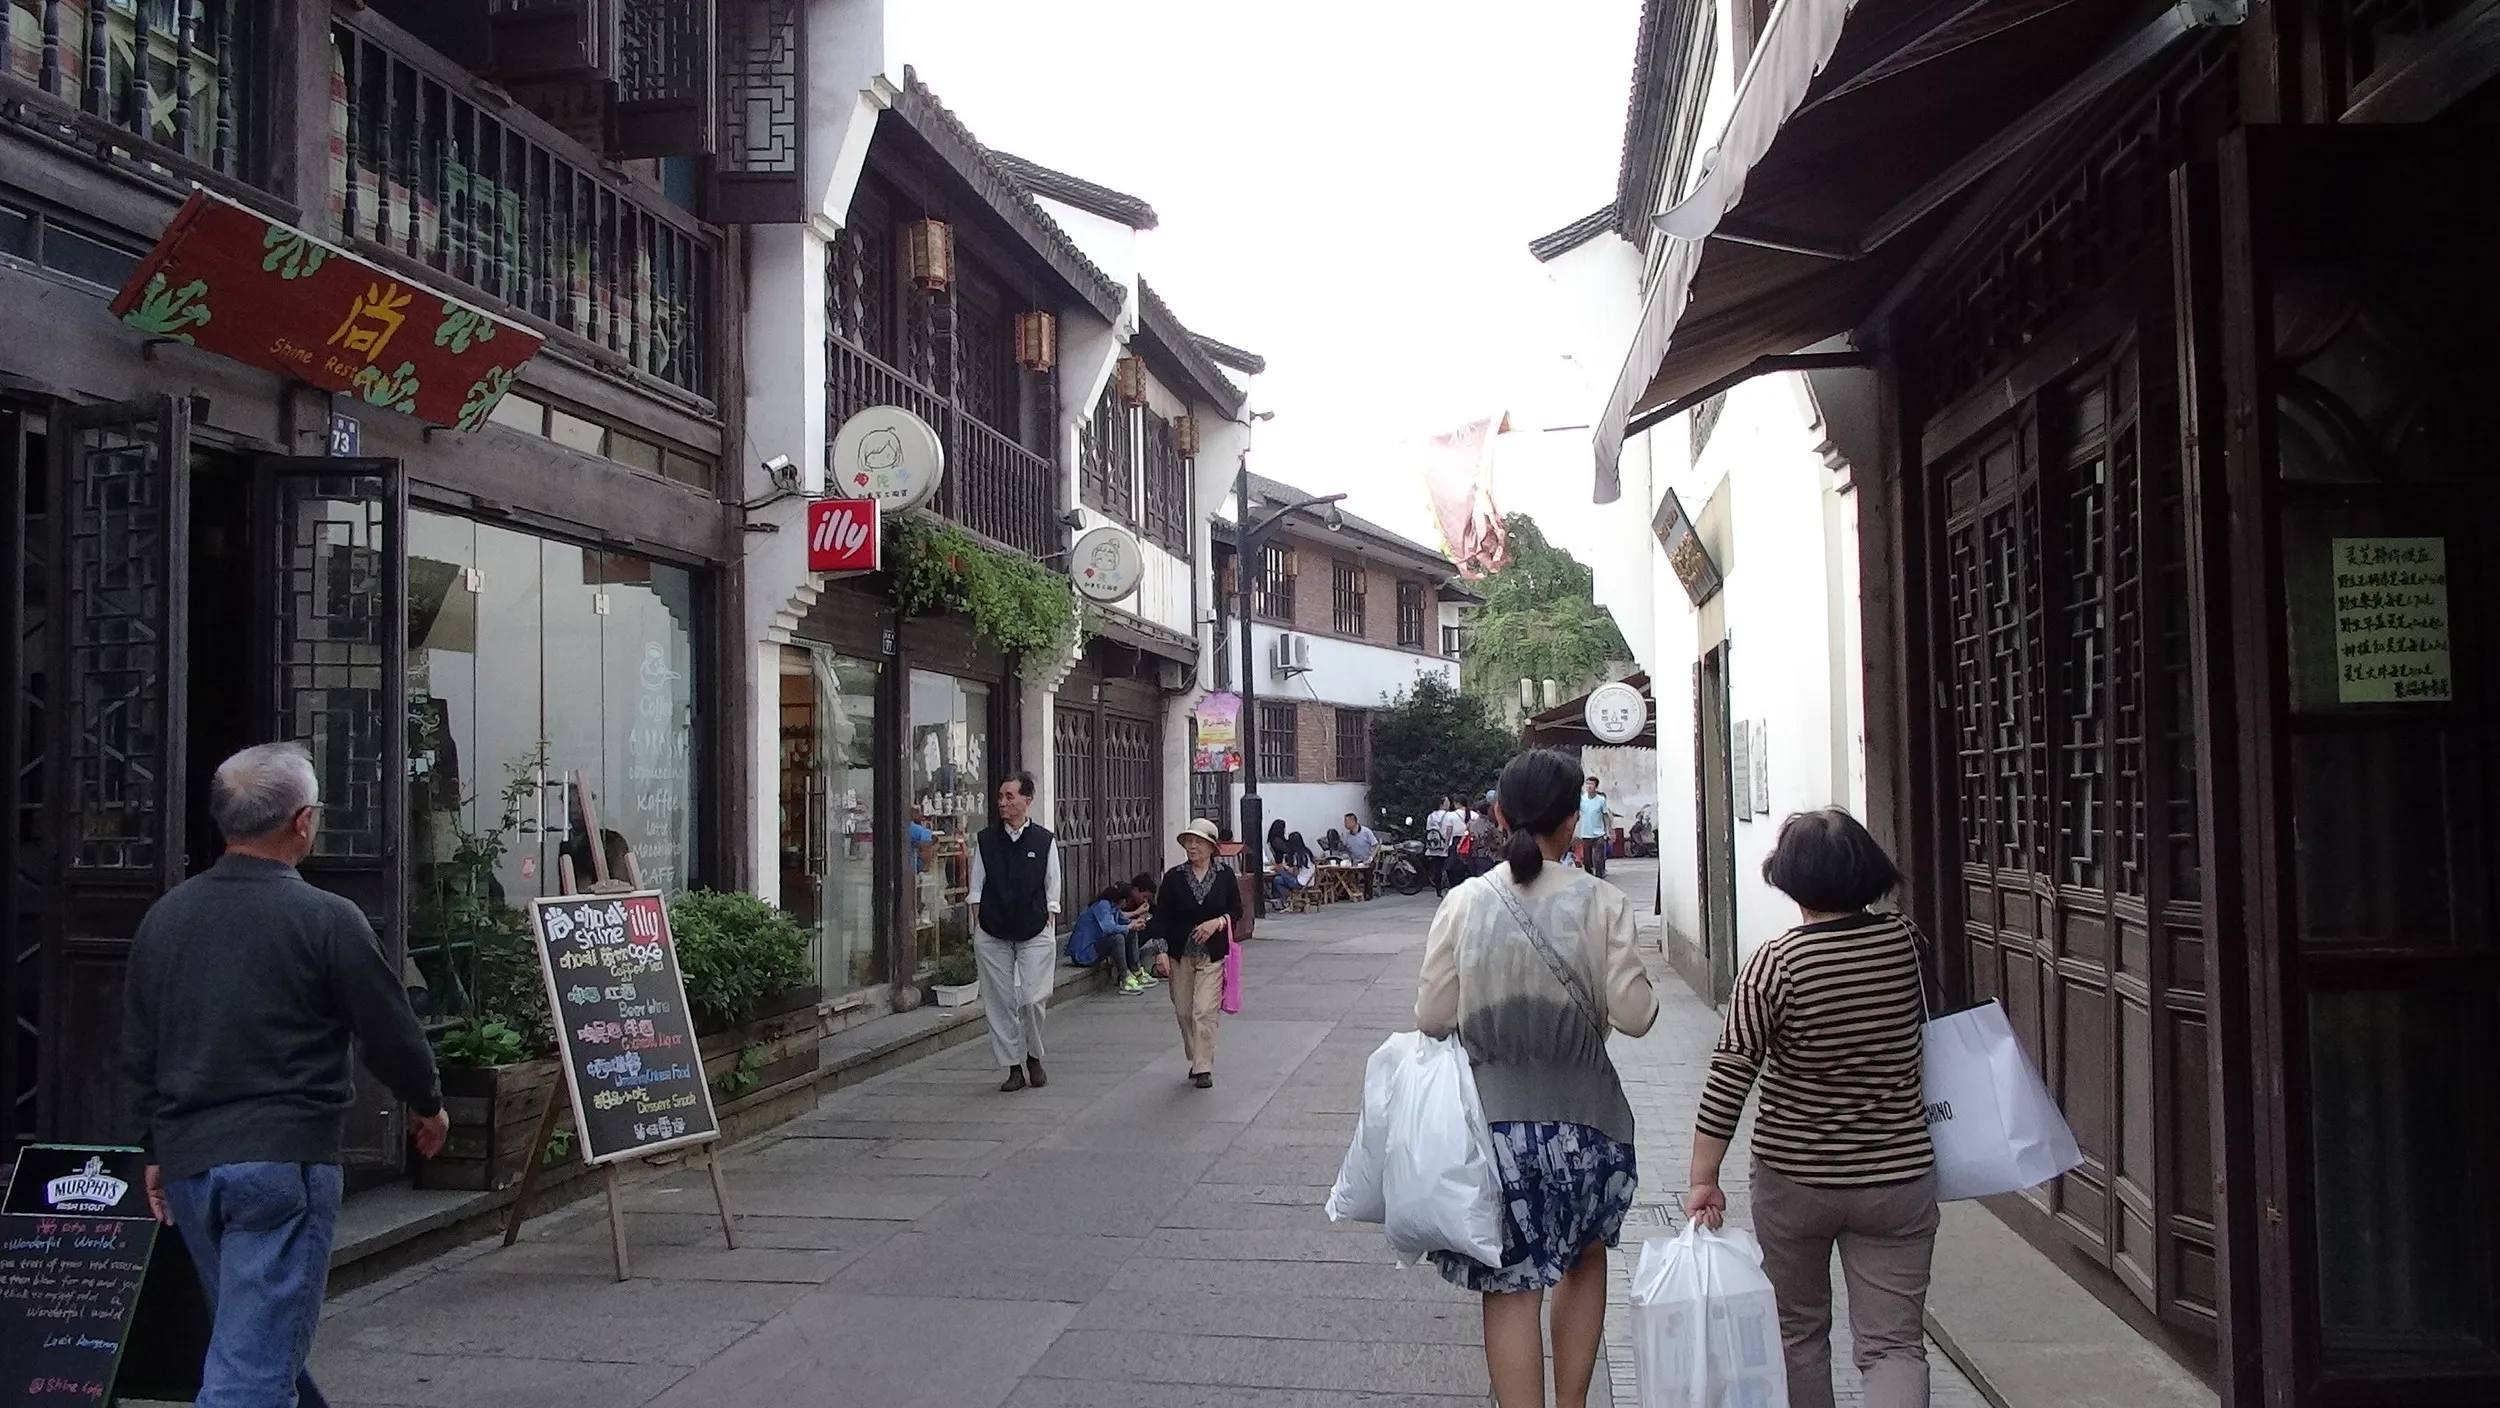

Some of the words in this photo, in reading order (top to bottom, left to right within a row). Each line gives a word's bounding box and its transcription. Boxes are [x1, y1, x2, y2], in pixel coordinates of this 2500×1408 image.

[326, 282, 412, 362] 尚
[270, 338, 313, 364] Shine
[332, 430, 350, 453] 73
[812, 509, 869, 559] illy
[630, 904, 659, 941] illy
